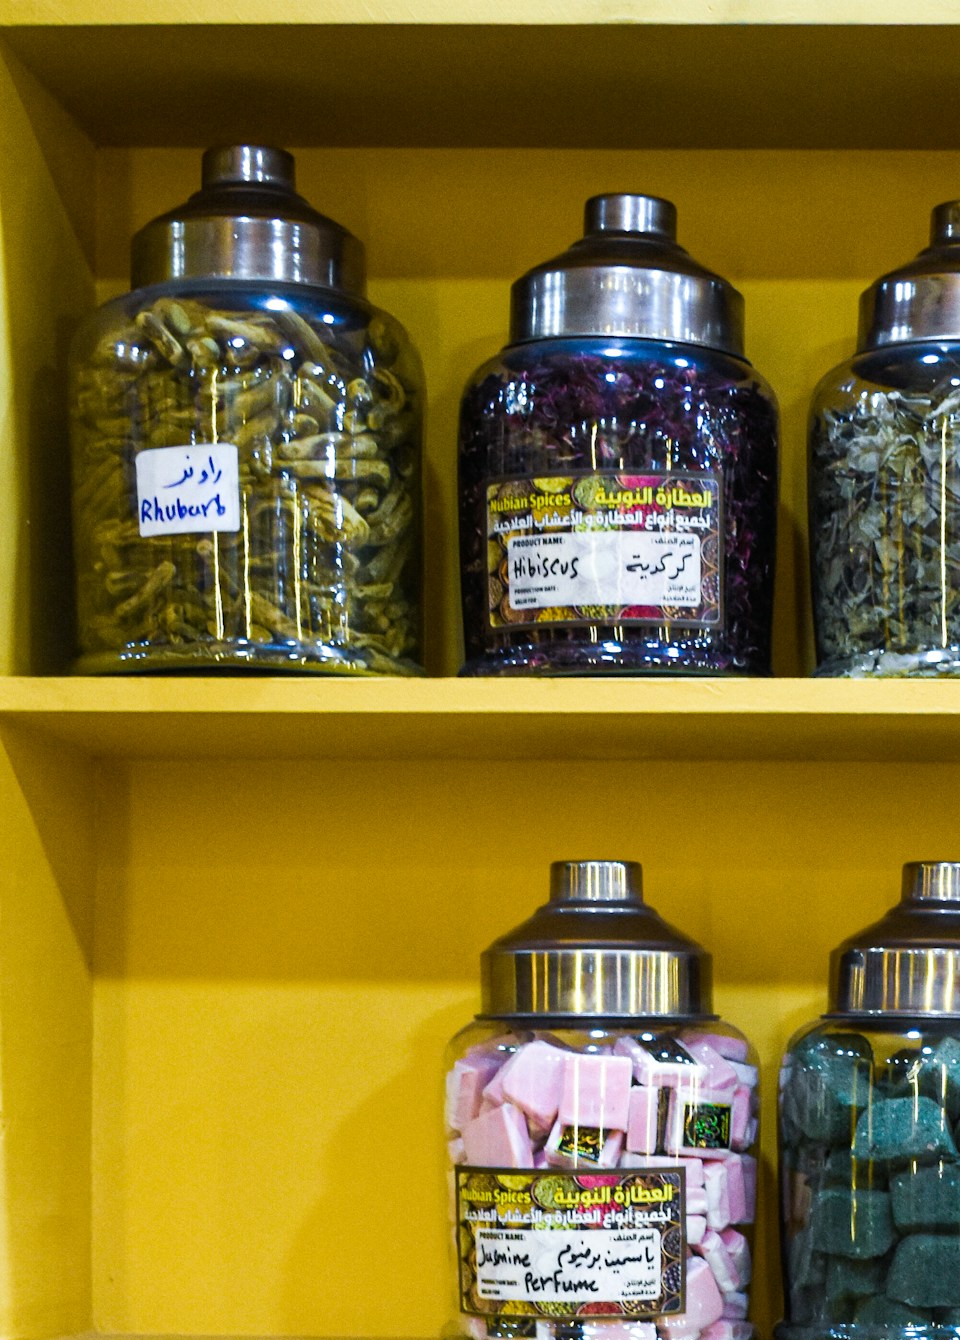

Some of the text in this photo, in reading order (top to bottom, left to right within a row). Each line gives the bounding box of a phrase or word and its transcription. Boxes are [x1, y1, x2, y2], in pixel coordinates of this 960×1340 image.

[141, 494, 226, 523] Rhubarb
[491, 493, 571, 511] Nubian Spices
[595, 487, 712, 509] العطارة النوبية
[494, 1190, 531, 1205] Spices
[554, 1184, 672, 1206] العطارة النوبية
